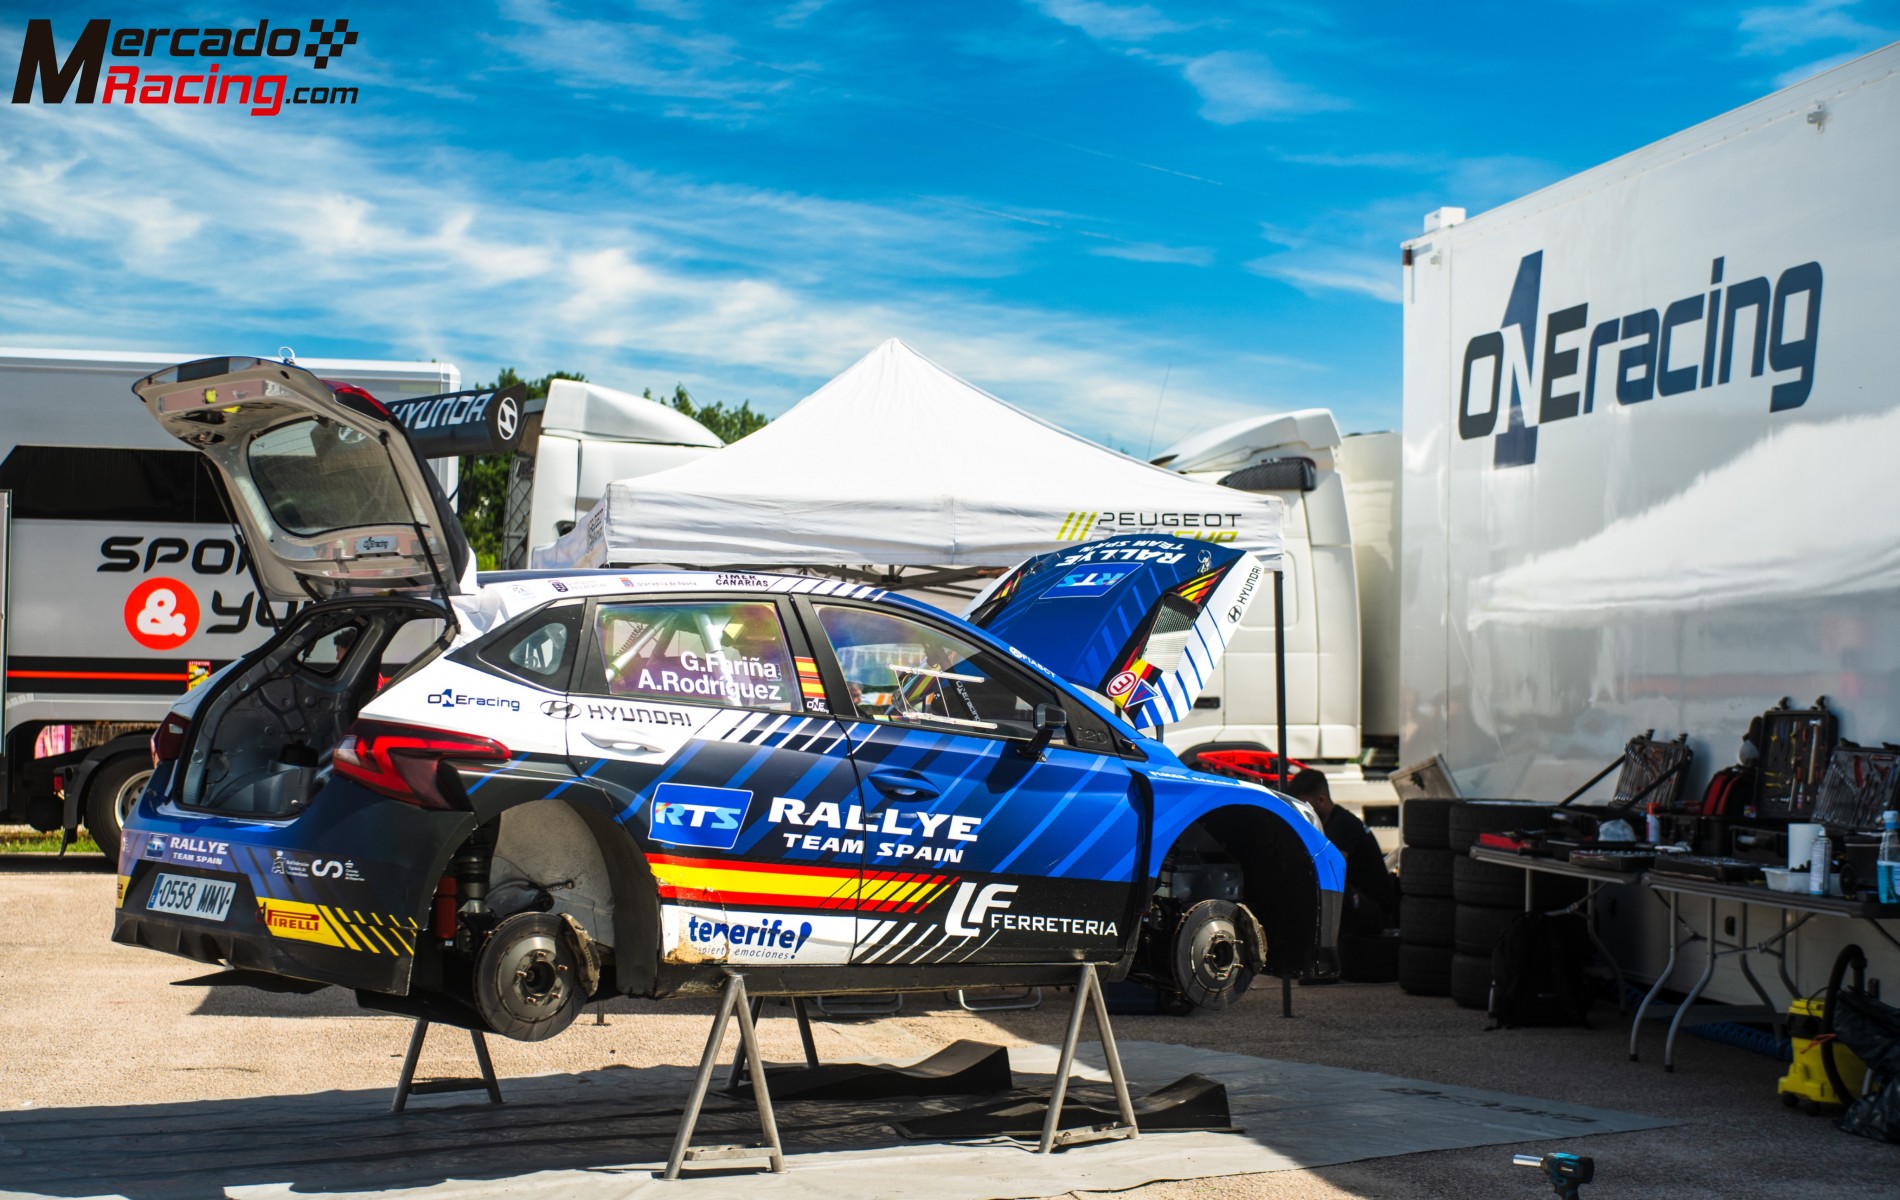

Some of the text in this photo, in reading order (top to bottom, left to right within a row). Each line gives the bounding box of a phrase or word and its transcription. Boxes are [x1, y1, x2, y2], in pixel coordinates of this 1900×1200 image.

[392, 393, 487, 429] HYUNDA
[1098, 512, 1242, 527] PEUGEOT
[1131, 540, 1185, 550] TEAM
[1055, 550, 1187, 567] RALLYE
[715, 579, 769, 587] CANARIAS
[1056, 572, 1126, 588] RTS
[1237, 566, 1262, 605] HYUNDAI
[680, 650, 776, 678] G.Fariña
[588, 705, 692, 727] HYUNDAI
[655, 802, 741, 830] RTS
[768, 797, 982, 842] RALLYE
[169, 837, 229, 855] RALLYE
[783, 833, 964, 863] TEAM SPAIN
[173, 852, 223, 865] TEAM SPAIN
[160, 880, 196, 910] 0558
[197, 884, 231, 915] MMV
[256, 905, 319, 931] PIRELLI
[991, 914, 1118, 937] FERRETERIA
[735, 947, 788, 959] emociones
